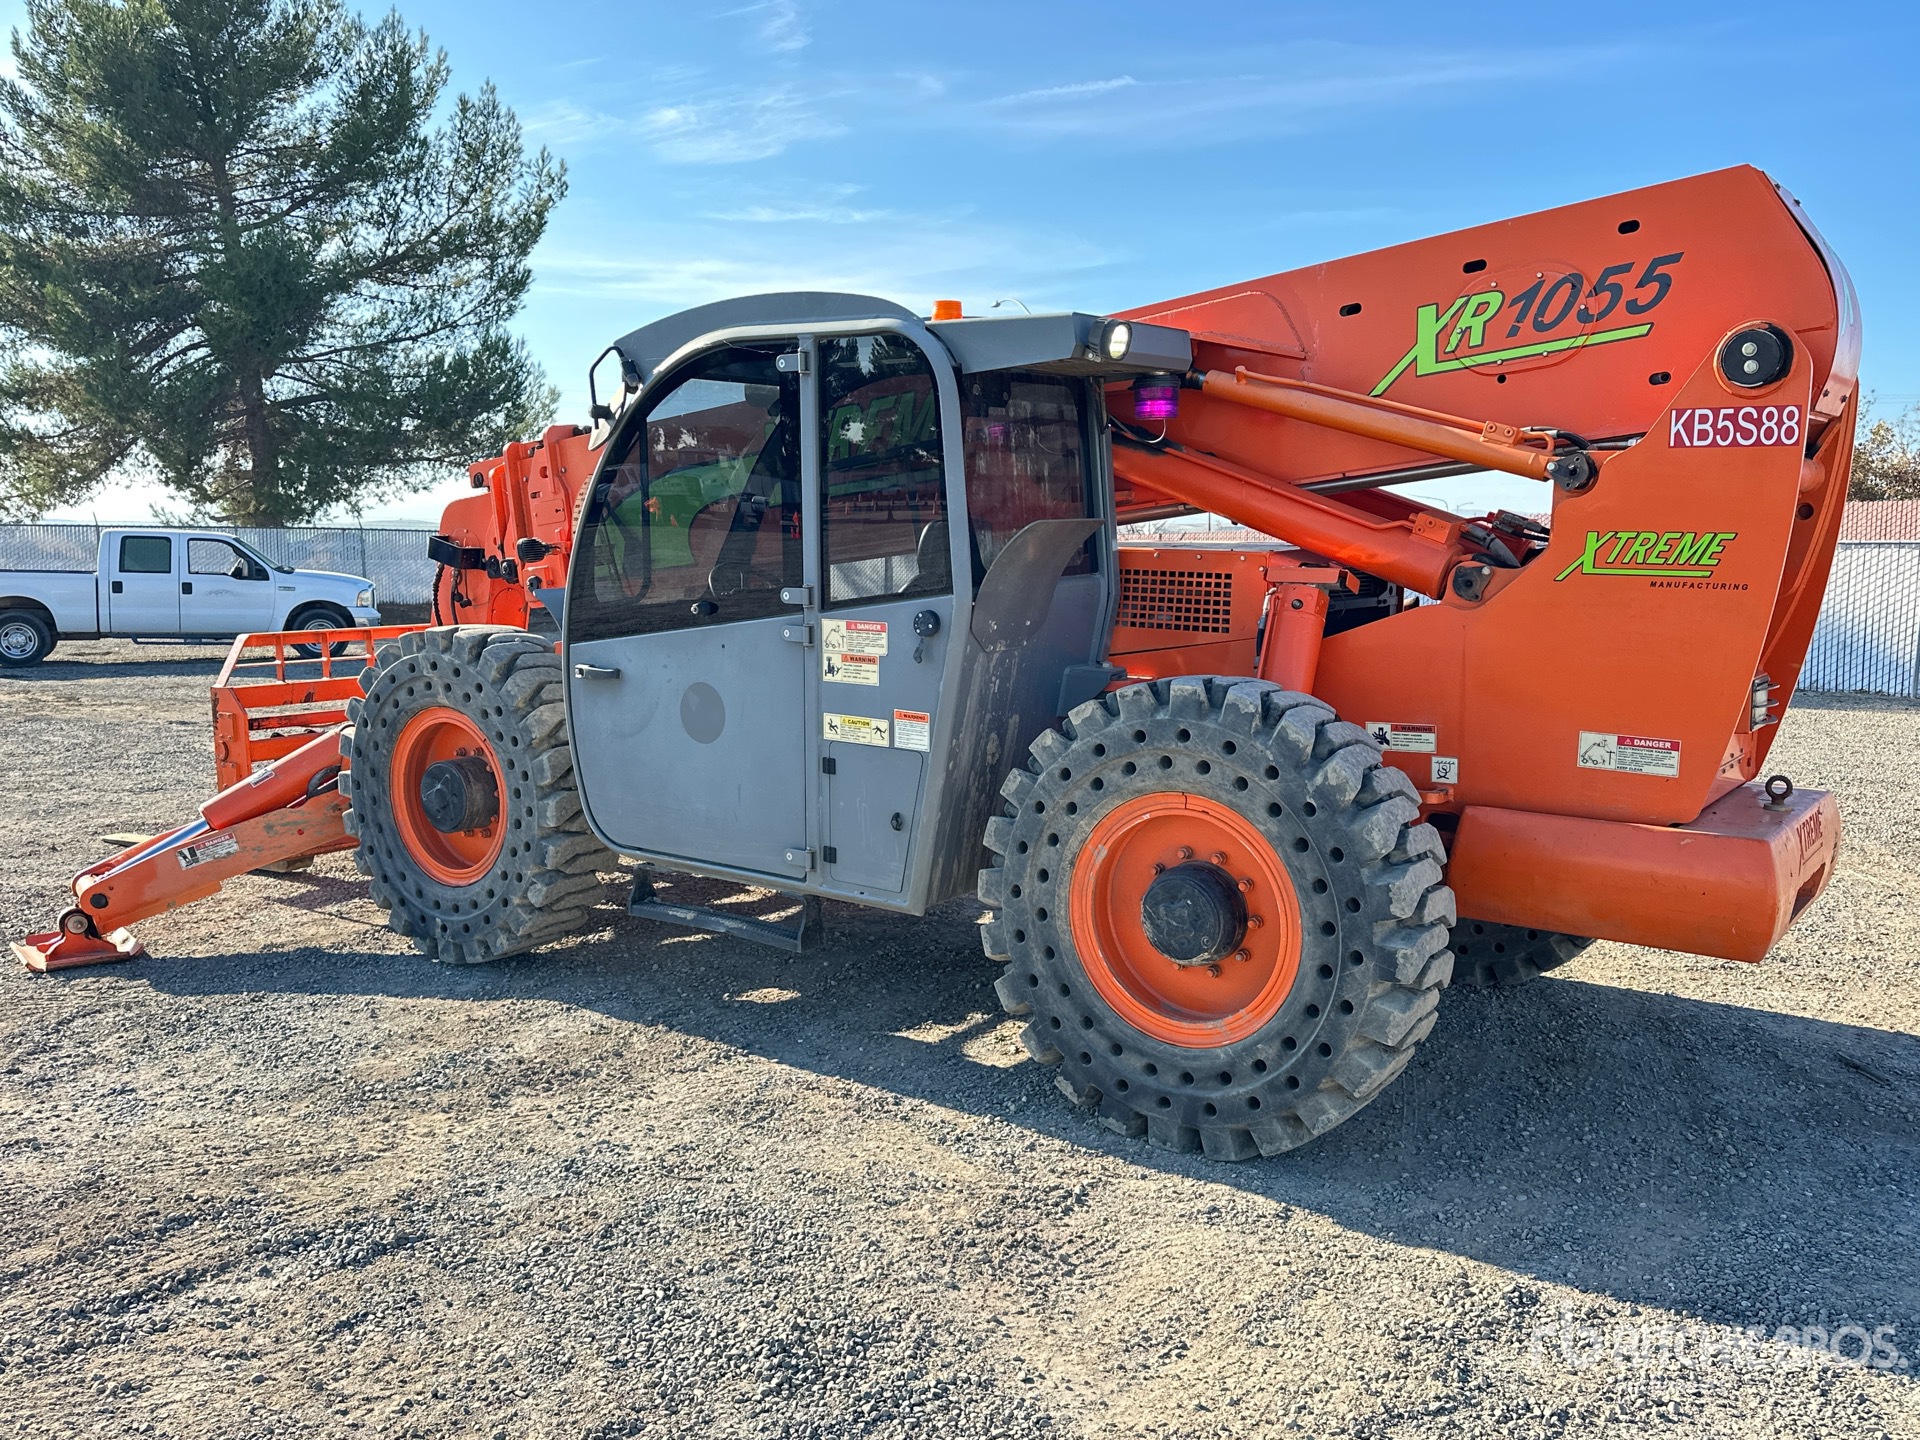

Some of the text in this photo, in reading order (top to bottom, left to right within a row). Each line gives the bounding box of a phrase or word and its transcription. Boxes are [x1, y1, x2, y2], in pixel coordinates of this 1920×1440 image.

[1669, 406, 1799, 447] KB5S88
[1554, 531, 1738, 581] XTREME
[1649, 581, 1749, 591] MANUFACTURING
[856, 623, 881, 631] DANGER
[850, 656, 876, 664] WARNING
[847, 719, 870, 727] CAUTION
[1633, 739, 1672, 749] DANGER
[204, 834, 230, 847] DANGER
